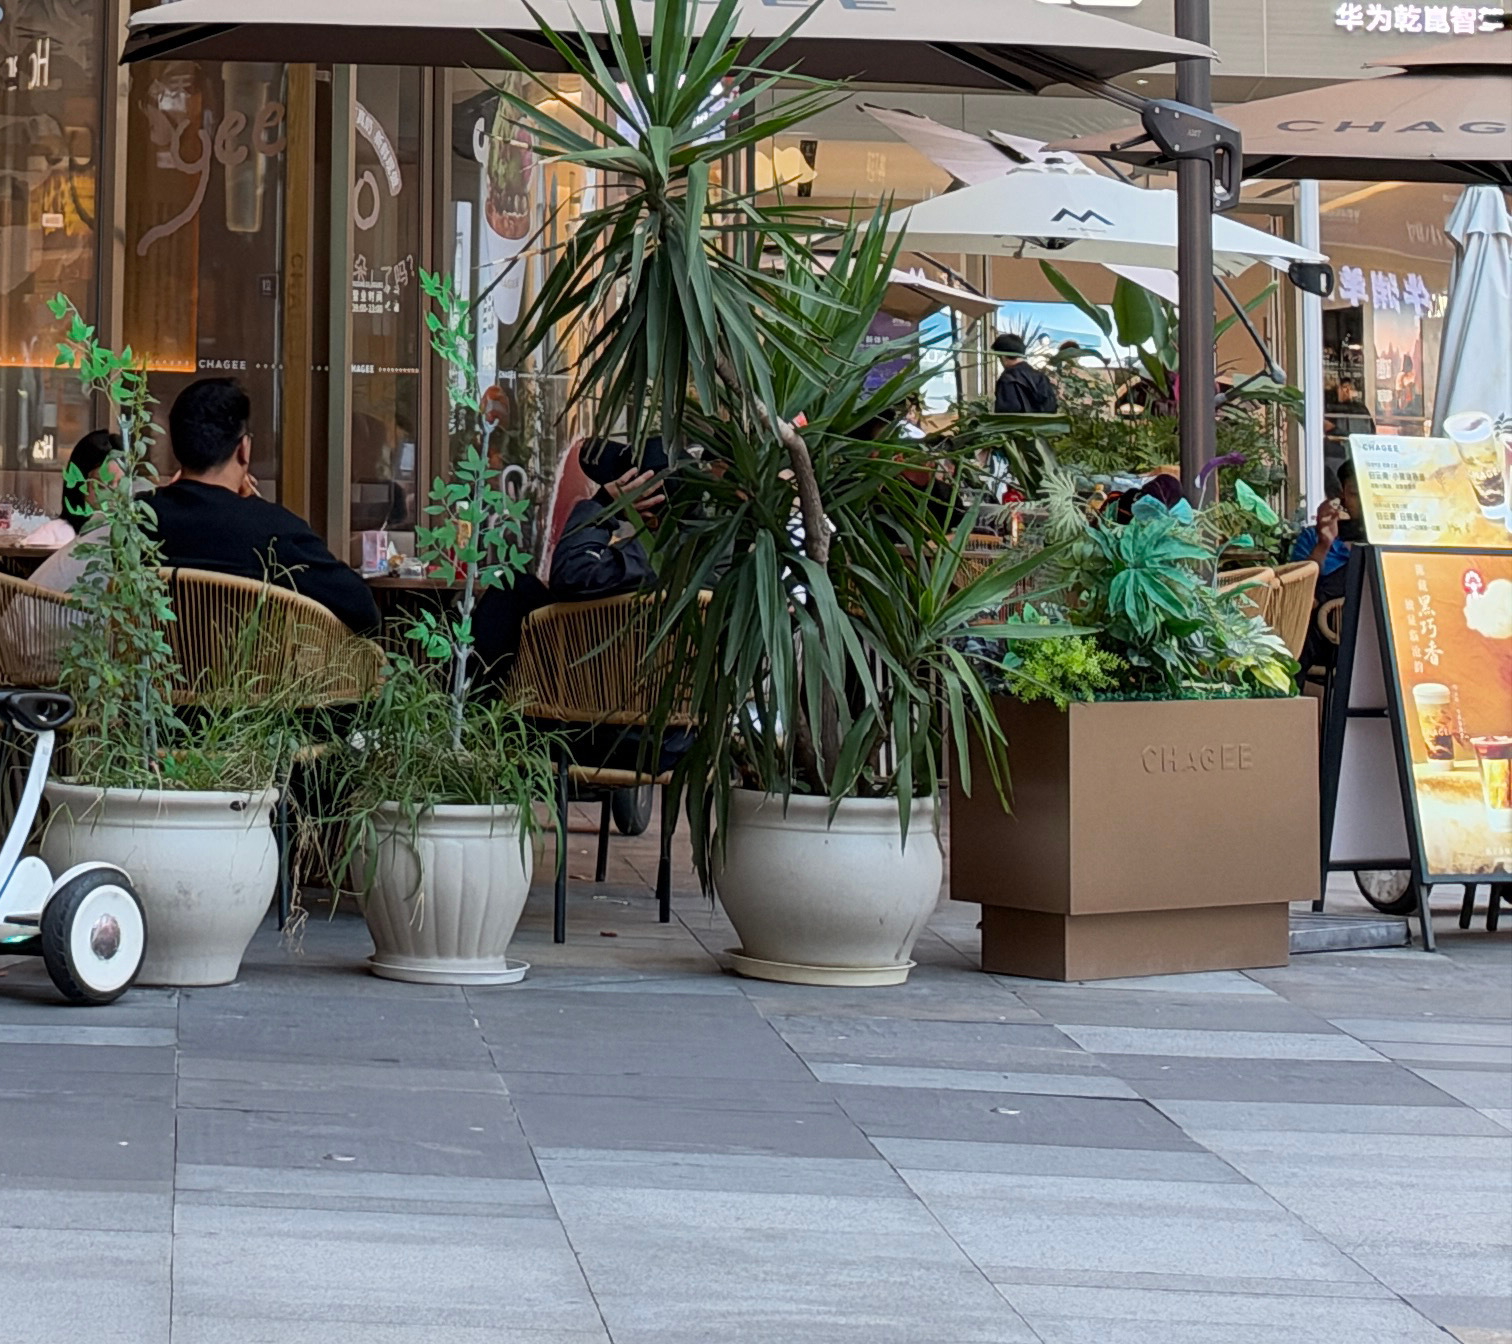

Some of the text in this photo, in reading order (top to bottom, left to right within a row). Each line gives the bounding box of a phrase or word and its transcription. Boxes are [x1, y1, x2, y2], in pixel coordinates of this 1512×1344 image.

[1277, 119, 1507, 134] CHAG
[198, 359, 247, 370] CHAGEE
[1362, 443, 1400, 453] CHAGEE
[1141, 743, 1254, 774] CHAGEE
